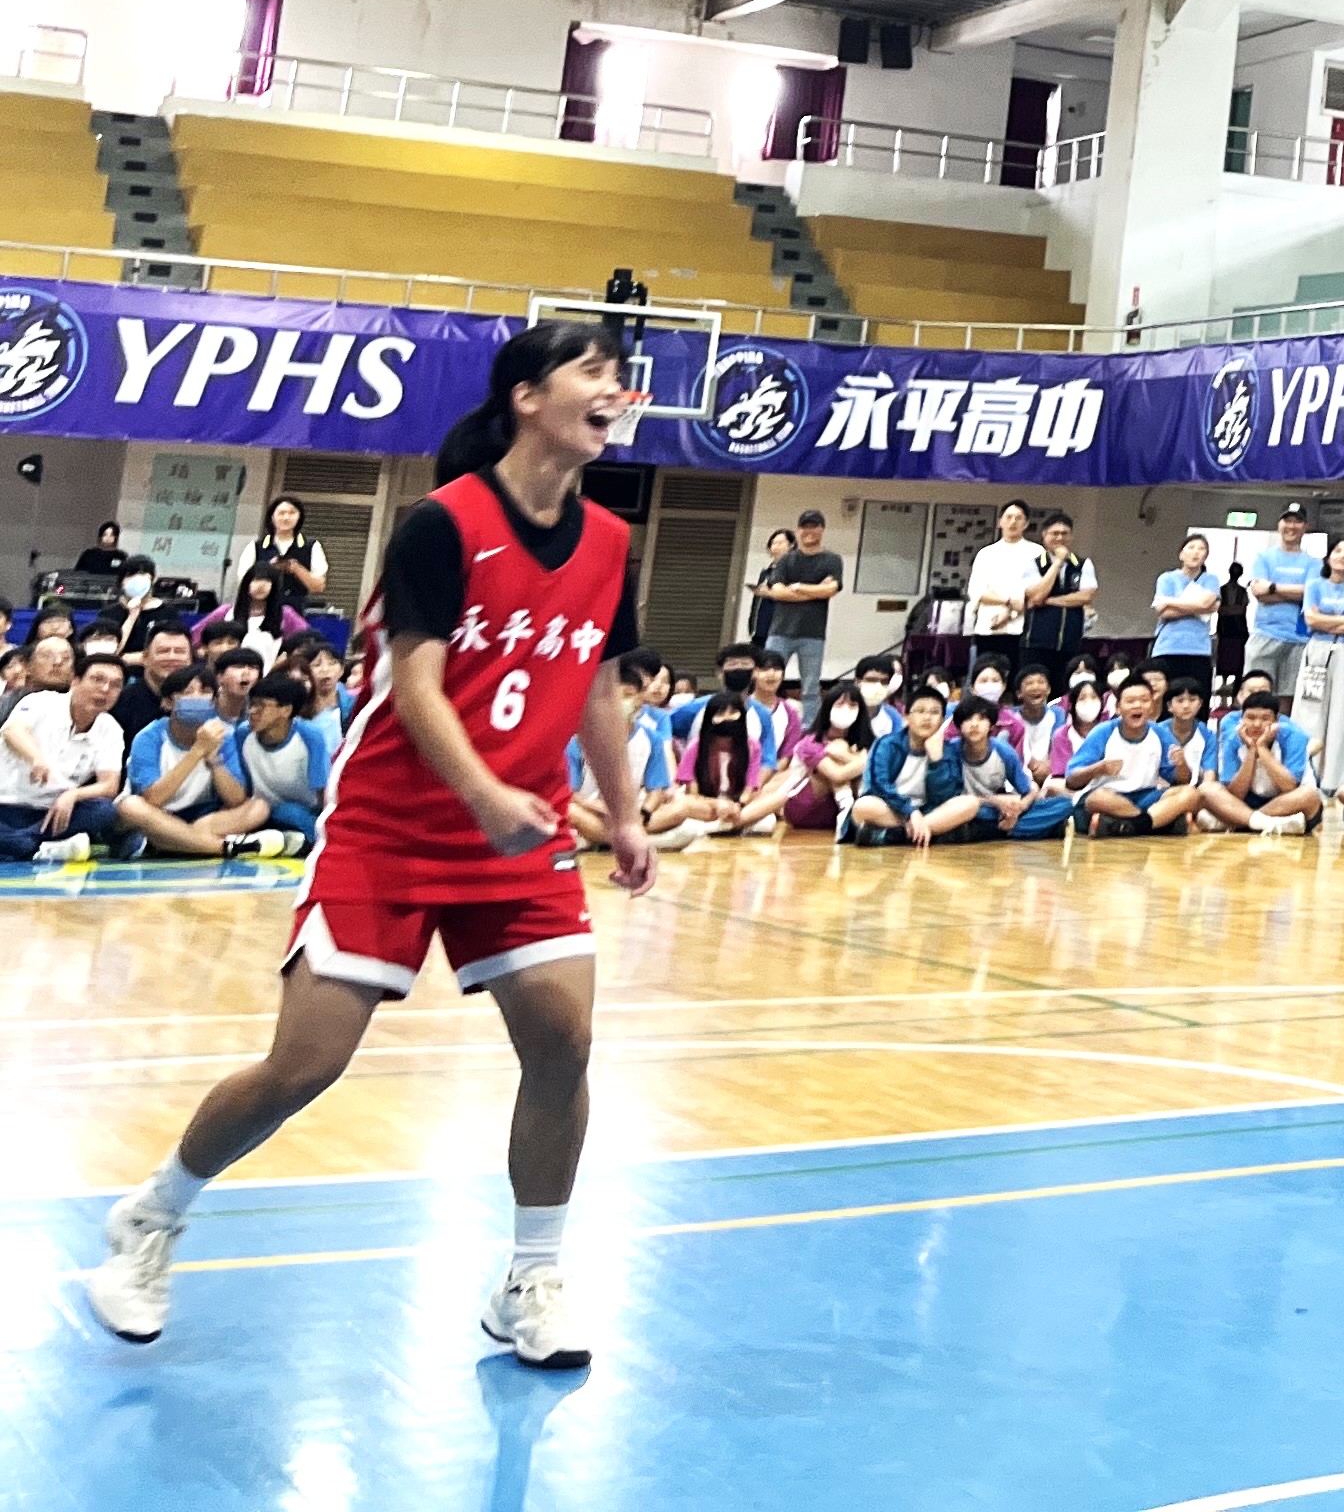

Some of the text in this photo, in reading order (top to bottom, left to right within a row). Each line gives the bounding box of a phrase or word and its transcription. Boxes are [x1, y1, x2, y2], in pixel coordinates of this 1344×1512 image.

[114, 318, 416, 420] YPHS
[816, 373, 1103, 459] 永平高中
[450, 604, 606, 665] 永平高中
[490, 669, 531, 732] 6
